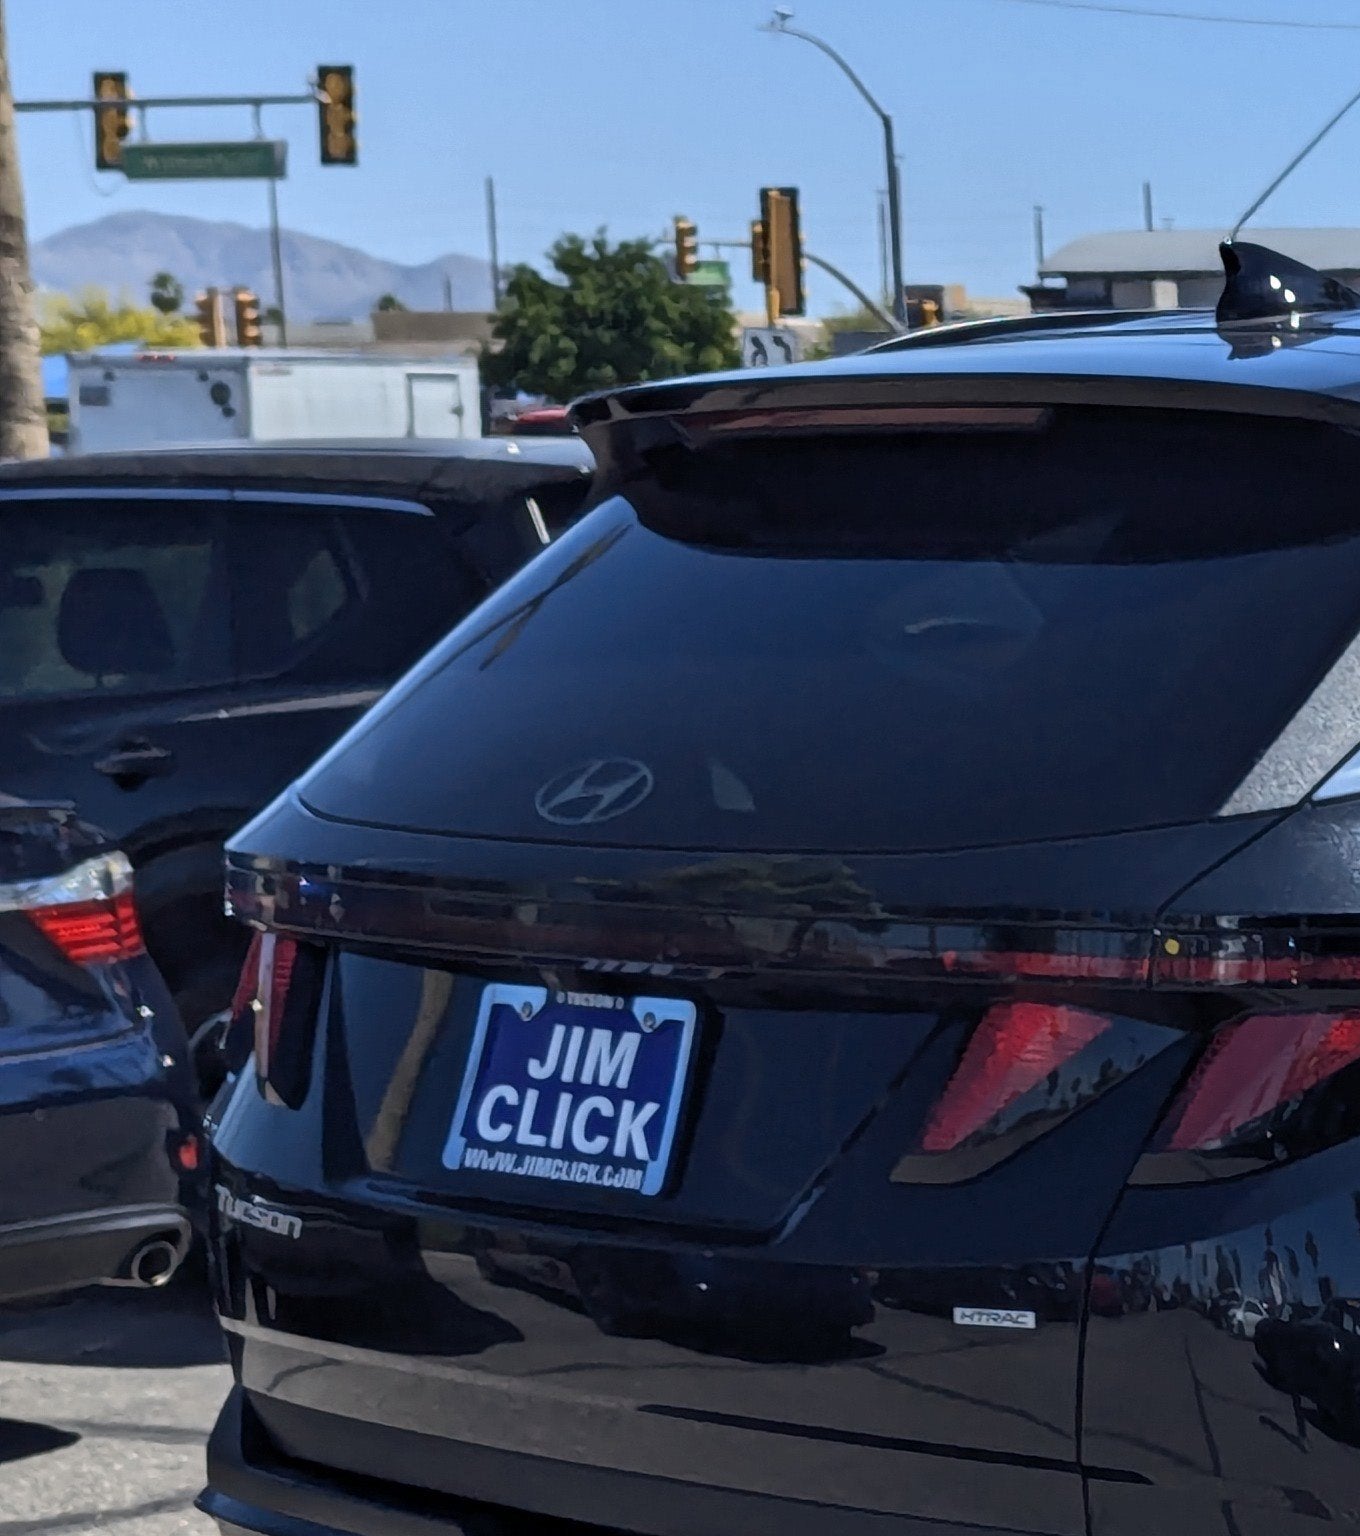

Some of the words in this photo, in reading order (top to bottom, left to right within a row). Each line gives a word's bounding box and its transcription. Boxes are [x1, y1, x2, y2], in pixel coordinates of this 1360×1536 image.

[527, 1023, 642, 1090] JIM
[476, 1084, 661, 1162] CLICK
[464, 1147, 644, 1190] WWW.JIMCLICK.COM
[960, 1311, 1029, 1325] HTRAC
